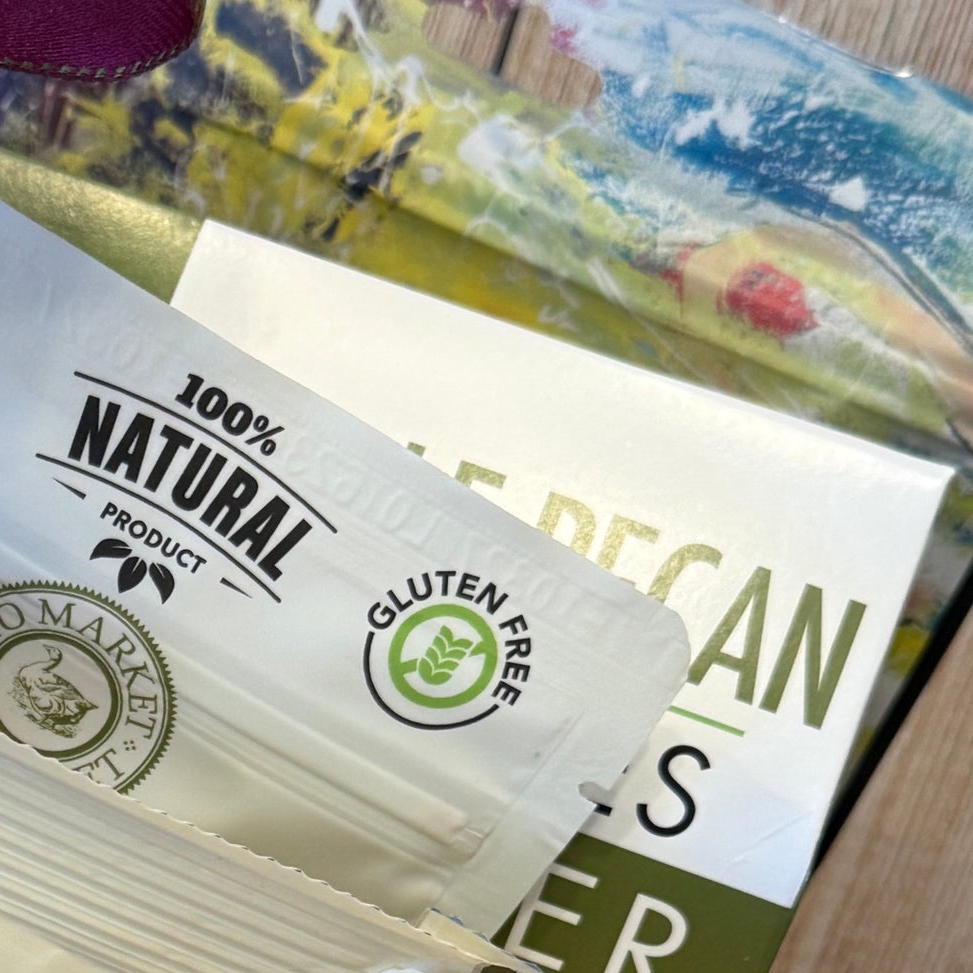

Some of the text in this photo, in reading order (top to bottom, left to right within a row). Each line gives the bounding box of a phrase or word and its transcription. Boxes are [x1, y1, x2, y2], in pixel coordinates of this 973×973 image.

[175, 373, 285, 456] 100%
[68, 395, 313, 582] NATURAL
[99, 502, 207, 574] PRODUCT
[38, 598, 159, 740] MARKET
[367, 571, 532, 706] GLUTEN FREE
